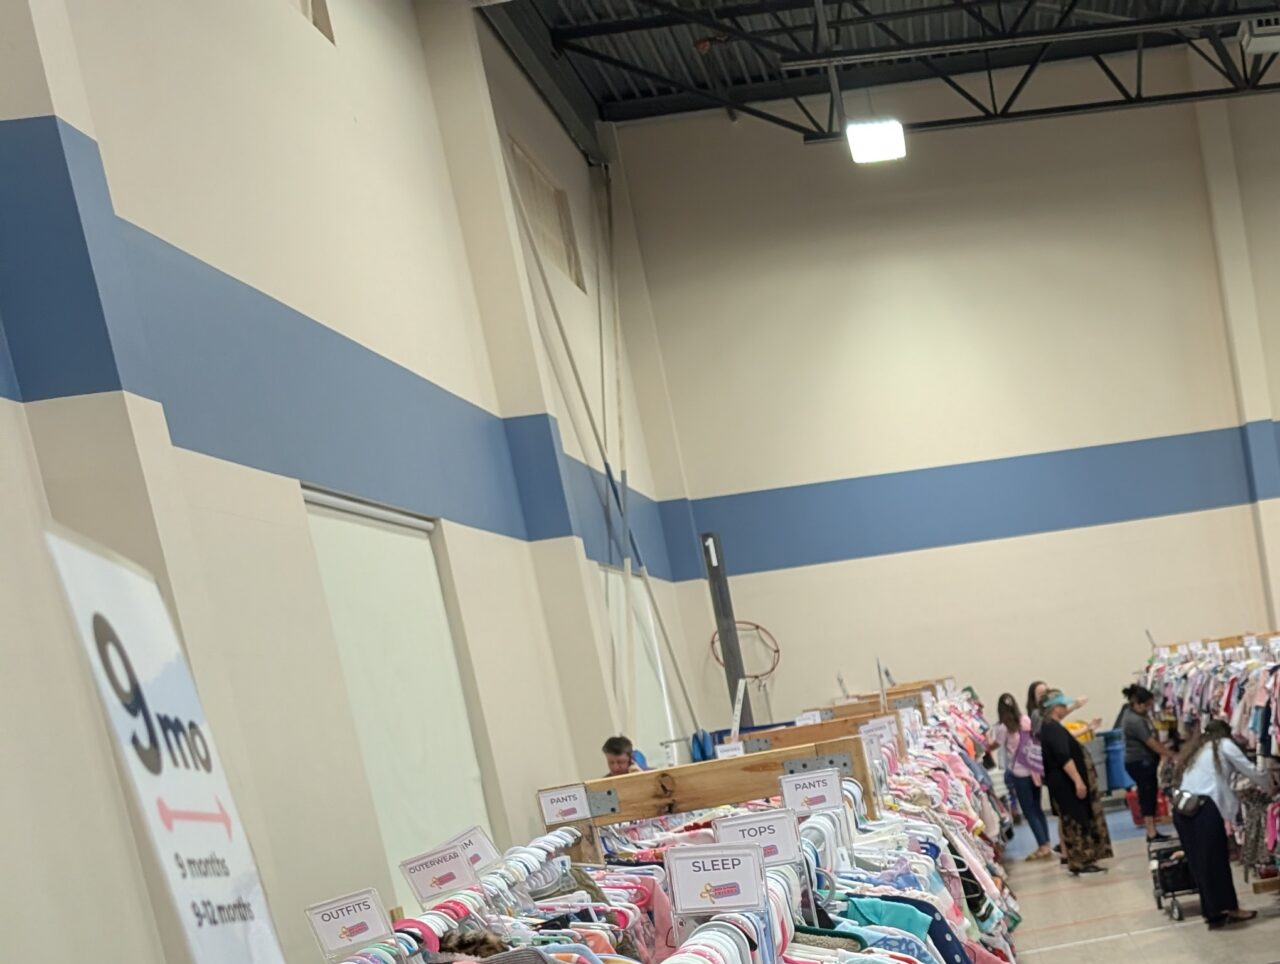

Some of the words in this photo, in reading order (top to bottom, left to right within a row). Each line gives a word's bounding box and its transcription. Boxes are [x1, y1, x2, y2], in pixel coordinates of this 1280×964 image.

[704, 537, 718, 567] 1
[794, 779, 828, 791] PANTS
[550, 793, 578, 804] PANTS
[738, 824, 776, 839] TOPS
[174, 852, 187, 879] 9
[186, 851, 231, 878] months
[408, 852, 459, 874] OUTERWEAR
[691, 857, 742, 873] SLEEP
[216, 895, 256, 924] months
[321, 900, 371, 922] OUTFITS
